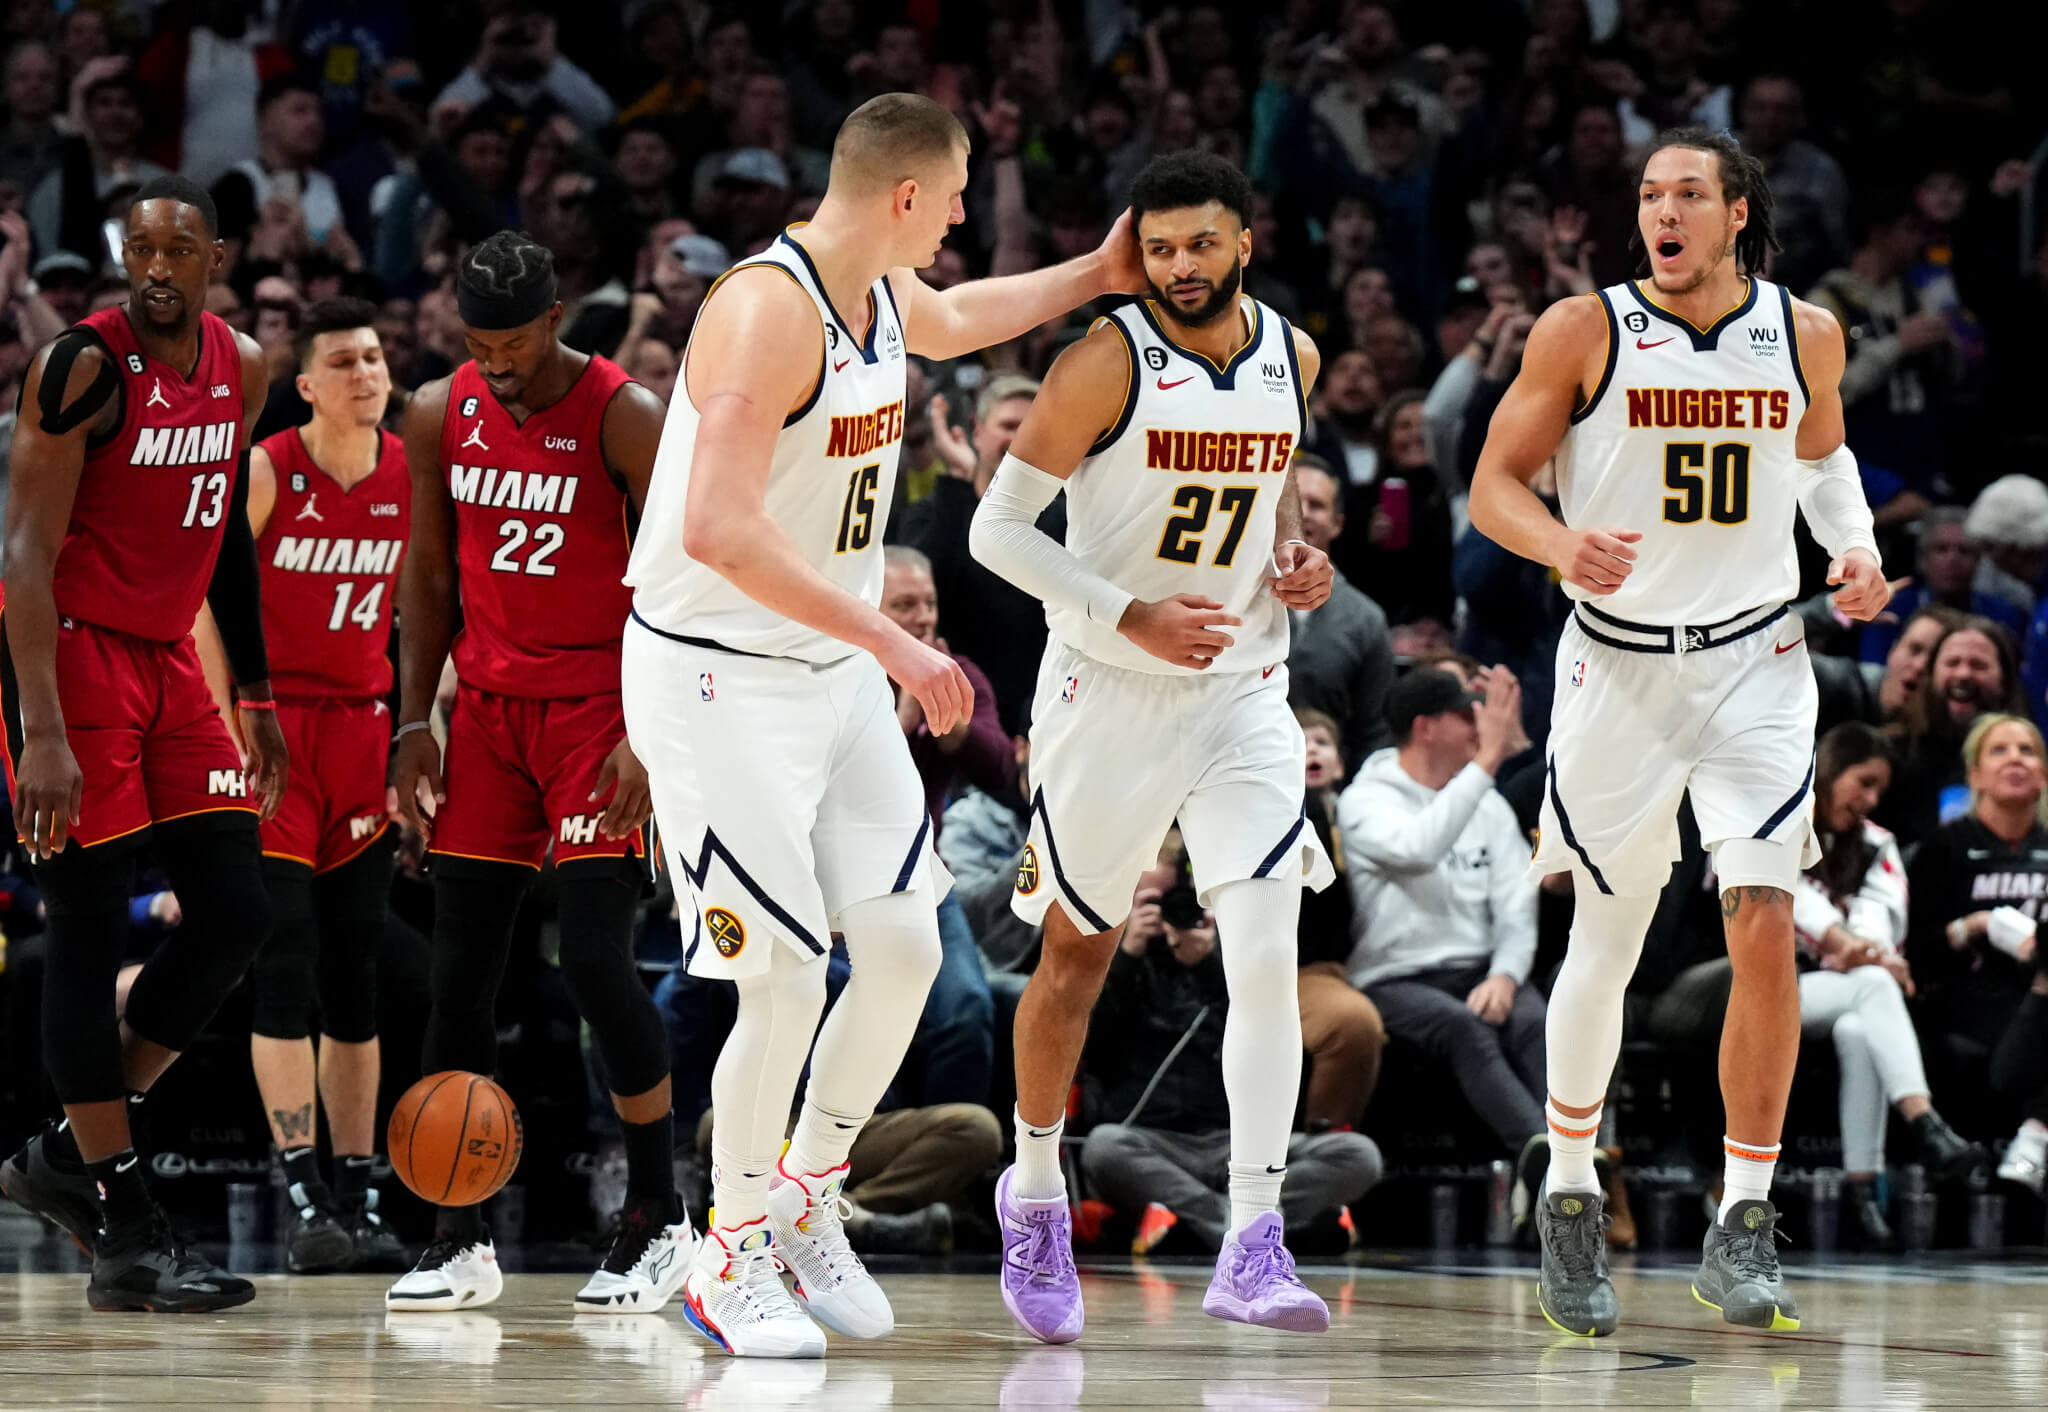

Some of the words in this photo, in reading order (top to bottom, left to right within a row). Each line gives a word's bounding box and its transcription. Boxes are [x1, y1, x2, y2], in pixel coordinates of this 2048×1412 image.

[1627, 315, 1644, 331] 6
[1748, 327, 1778, 343] WU
[128, 355, 141, 373] 6
[1147, 350, 1162, 369] 6
[1750, 343, 1780, 351] Western
[1260, 361, 1285, 379] WU
[210, 384, 230, 399] UKG
[462, 397, 478, 417] 6
[1626, 388, 1789, 430] NUGGETS
[130, 421, 236, 467] MIAMI
[545, 435, 577, 452] UKG
[1146, 428, 1294, 474] NUGGETS
[181, 472, 228, 529] 13
[450, 463, 579, 515] MIAMI
[1662, 440, 1752, 526] 50
[370, 503, 399, 517] UKG
[834, 461, 881, 555] 15
[1156, 483, 1260, 569] 27
[273, 536, 403, 575] MIAMI
[490, 518, 565, 577] 22
[328, 581, 386, 631] 14
